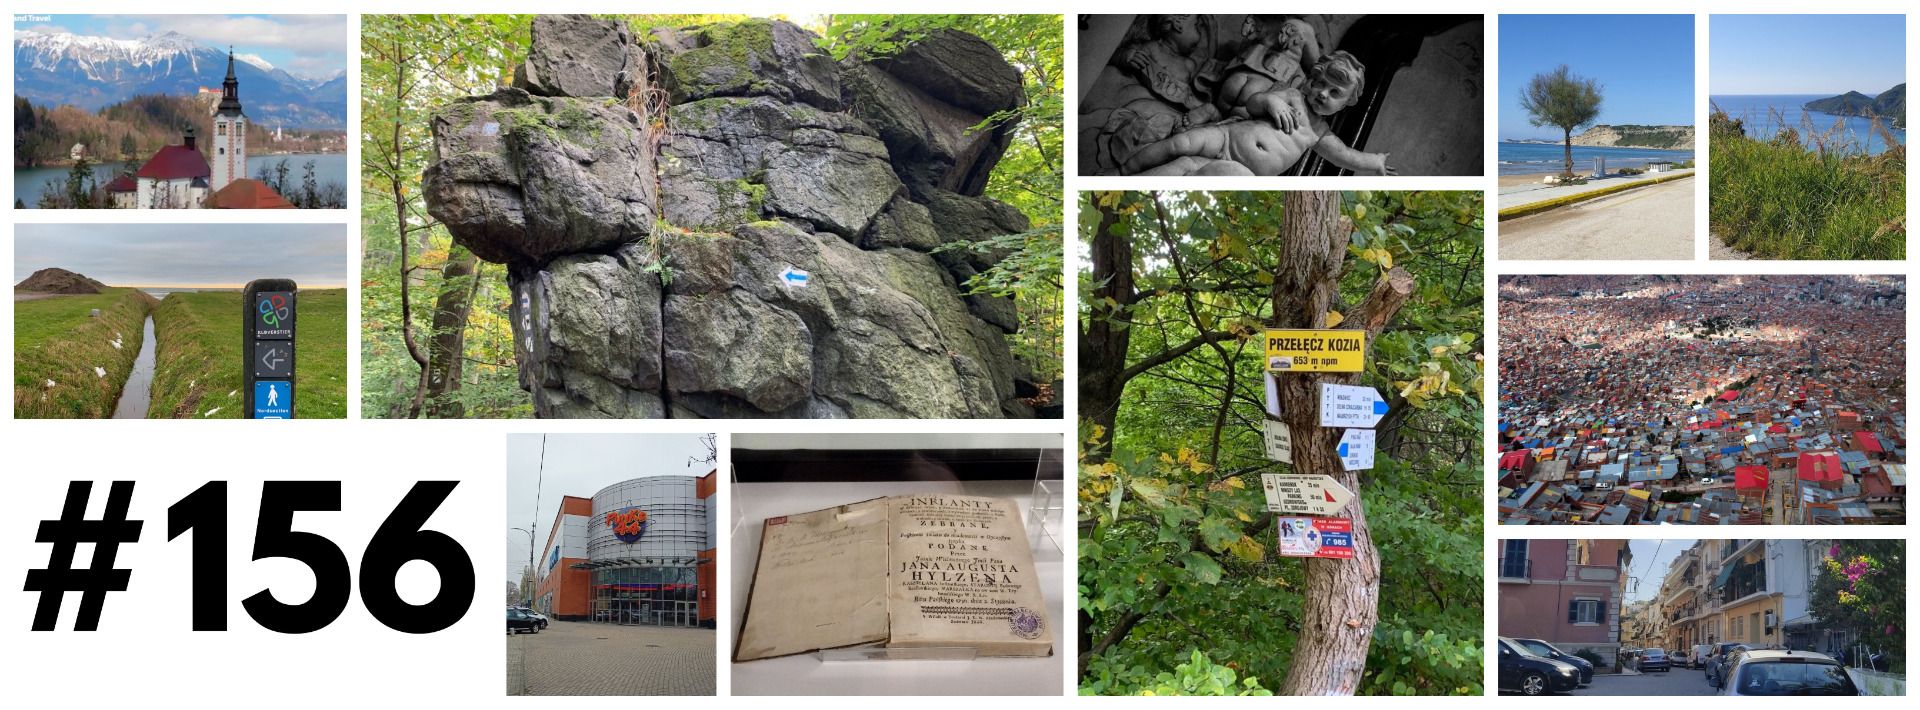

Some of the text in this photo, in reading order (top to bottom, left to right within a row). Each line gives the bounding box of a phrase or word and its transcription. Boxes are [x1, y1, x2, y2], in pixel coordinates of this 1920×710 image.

[1269, 338, 1361, 355] PRZEŁĘCZ KOZIA
[1293, 356, 1308, 365] 653
[1321, 358, 1338, 367] npm
[1332, 538, 1347, 546] 985
[901, 561, 1019, 573] JANA AUGUSTA
[912, 571, 1012, 584] HYLZENA
